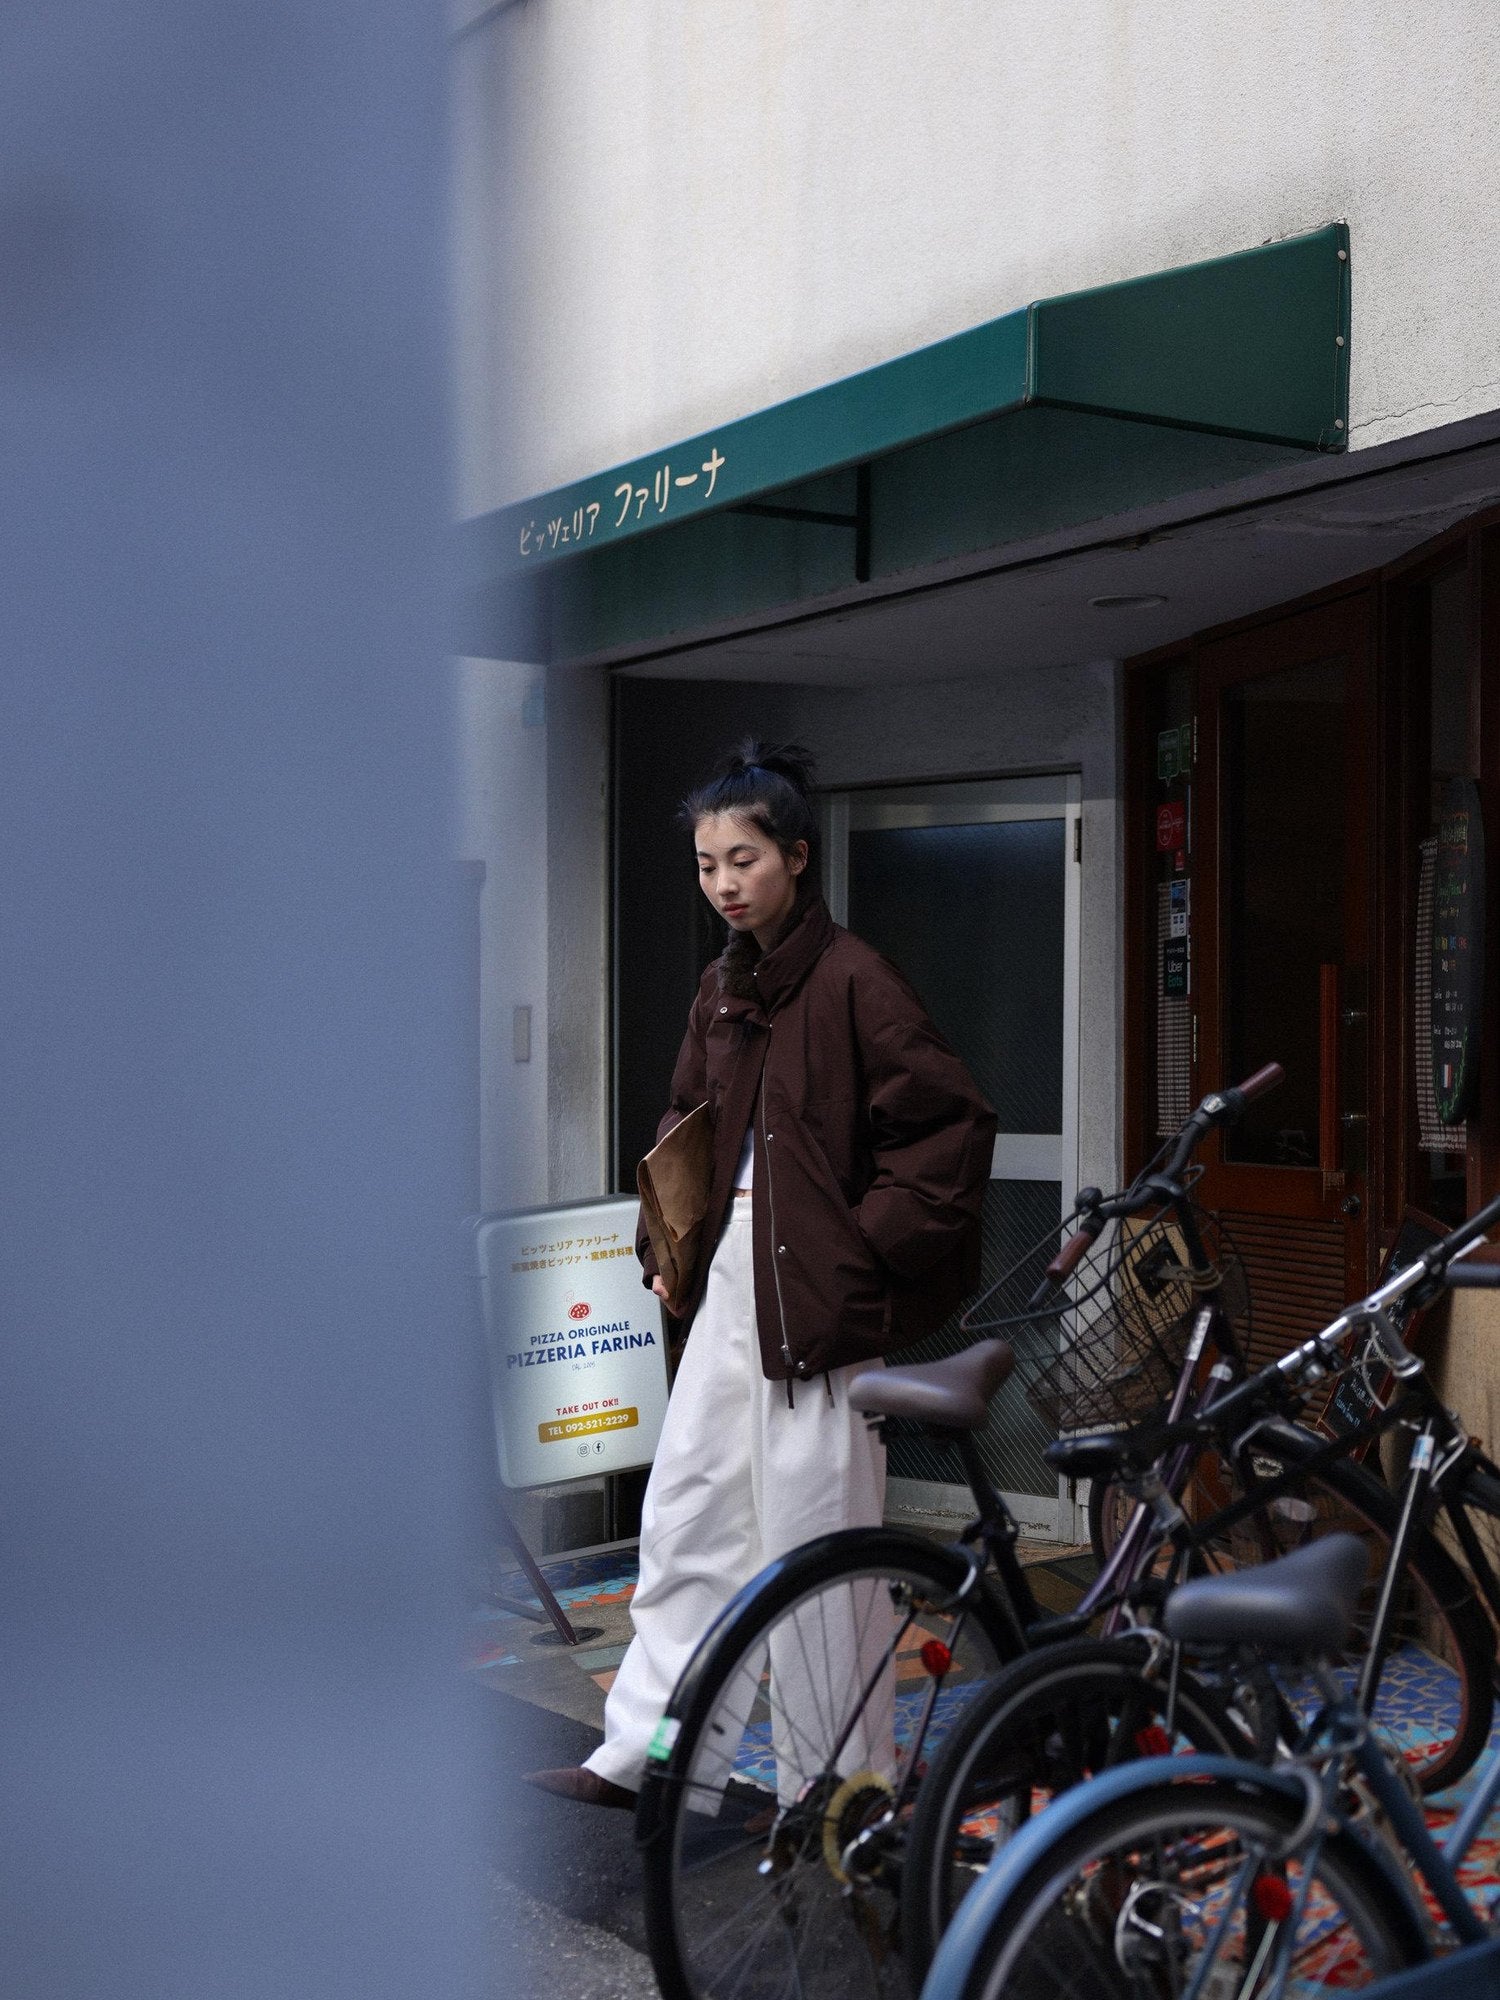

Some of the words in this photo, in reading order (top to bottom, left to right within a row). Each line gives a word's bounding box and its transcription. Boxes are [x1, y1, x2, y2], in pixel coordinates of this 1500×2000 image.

[520, 502, 600, 555] ピッツェリア
[614, 448, 726, 527] ファリーナ
[521, 1240, 573, 1256] ピッツェリア
[577, 1232, 619, 1248] ファリーナ
[530, 1332, 565, 1346] PIZZA
[568, 1320, 630, 1340] ORIGINALE
[506, 1343, 586, 1369] PIZZERIA
[592, 1331, 656, 1355] FARINA
[556, 1404, 579, 1416] TAKE
[582, 1401, 599, 1412] OUT
[602, 1398, 619, 1408] OK!!
[548, 1425, 564, 1436] TEL
[566, 1413, 629, 1433] 092-521-2229
